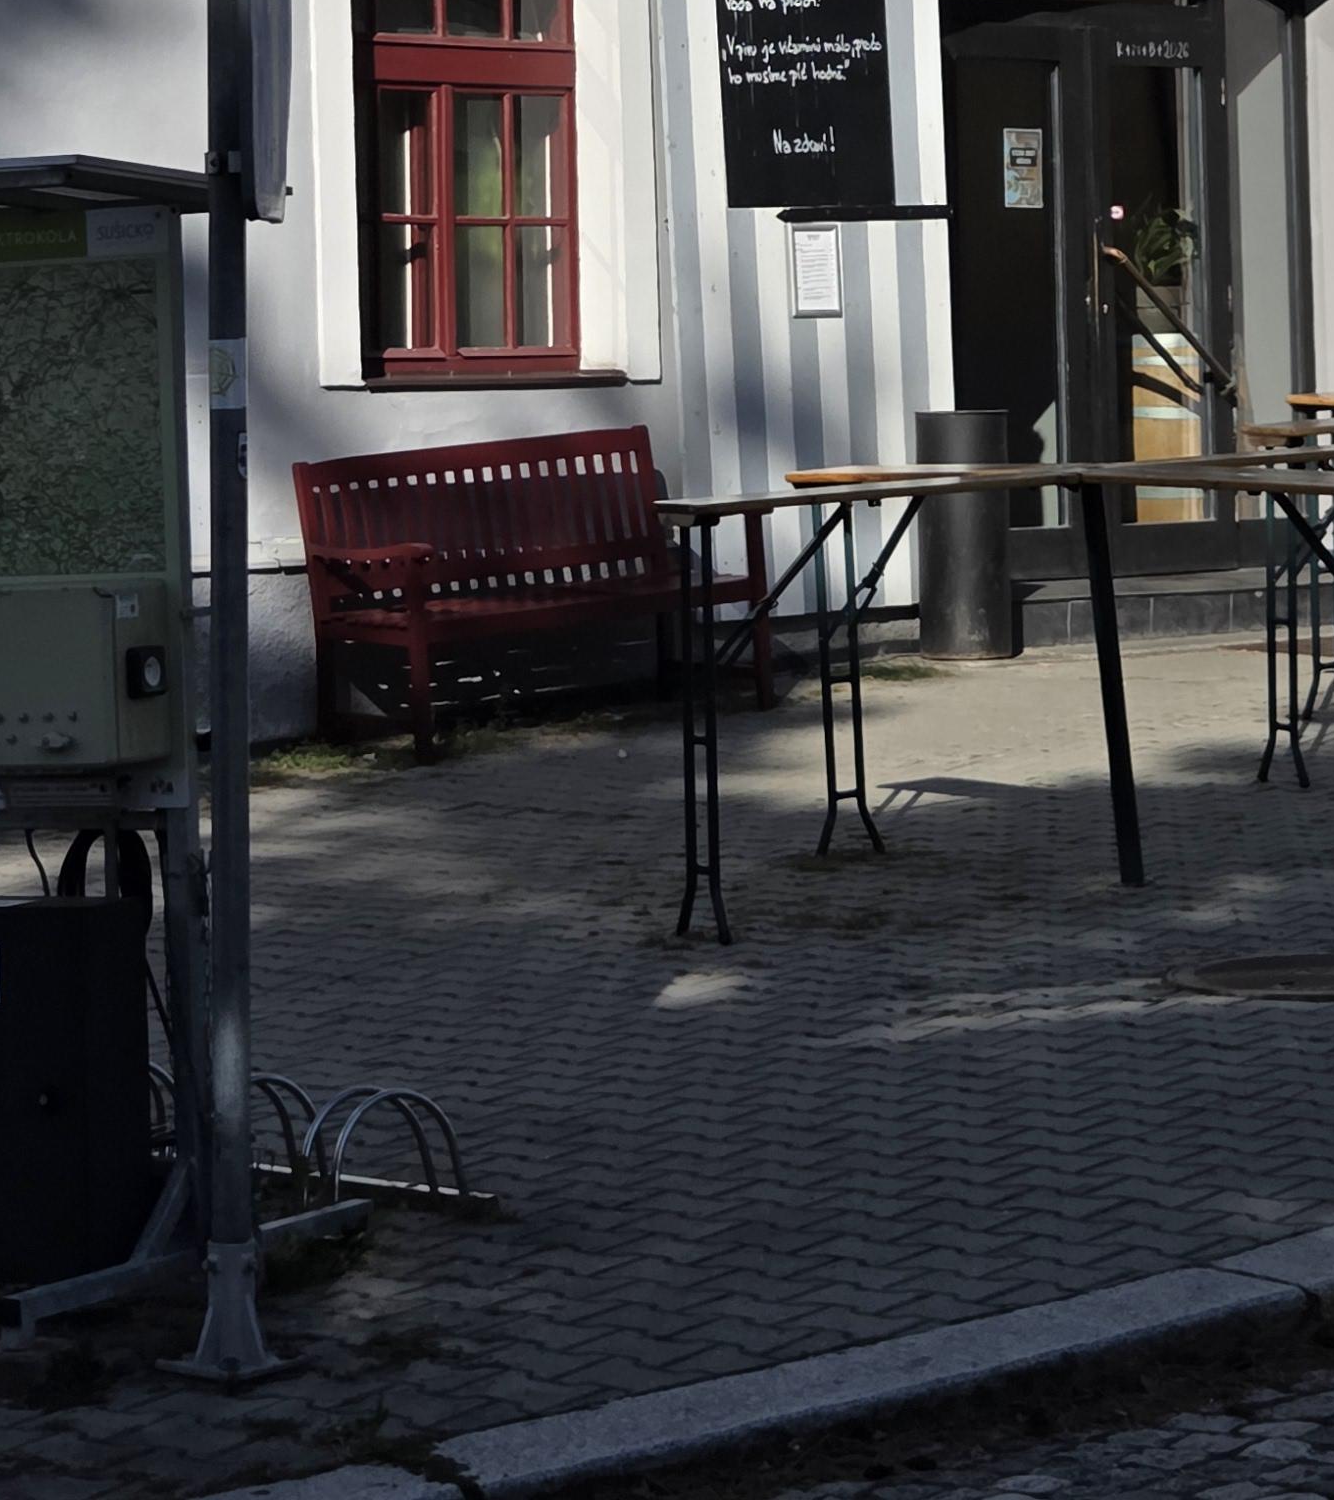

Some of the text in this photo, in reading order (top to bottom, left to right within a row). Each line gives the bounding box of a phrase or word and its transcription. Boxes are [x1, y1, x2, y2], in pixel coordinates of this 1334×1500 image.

[761, 39, 776, 63] je
[772, 128, 792, 155] Na
[94, 220, 155, 242] SUŠICKO
